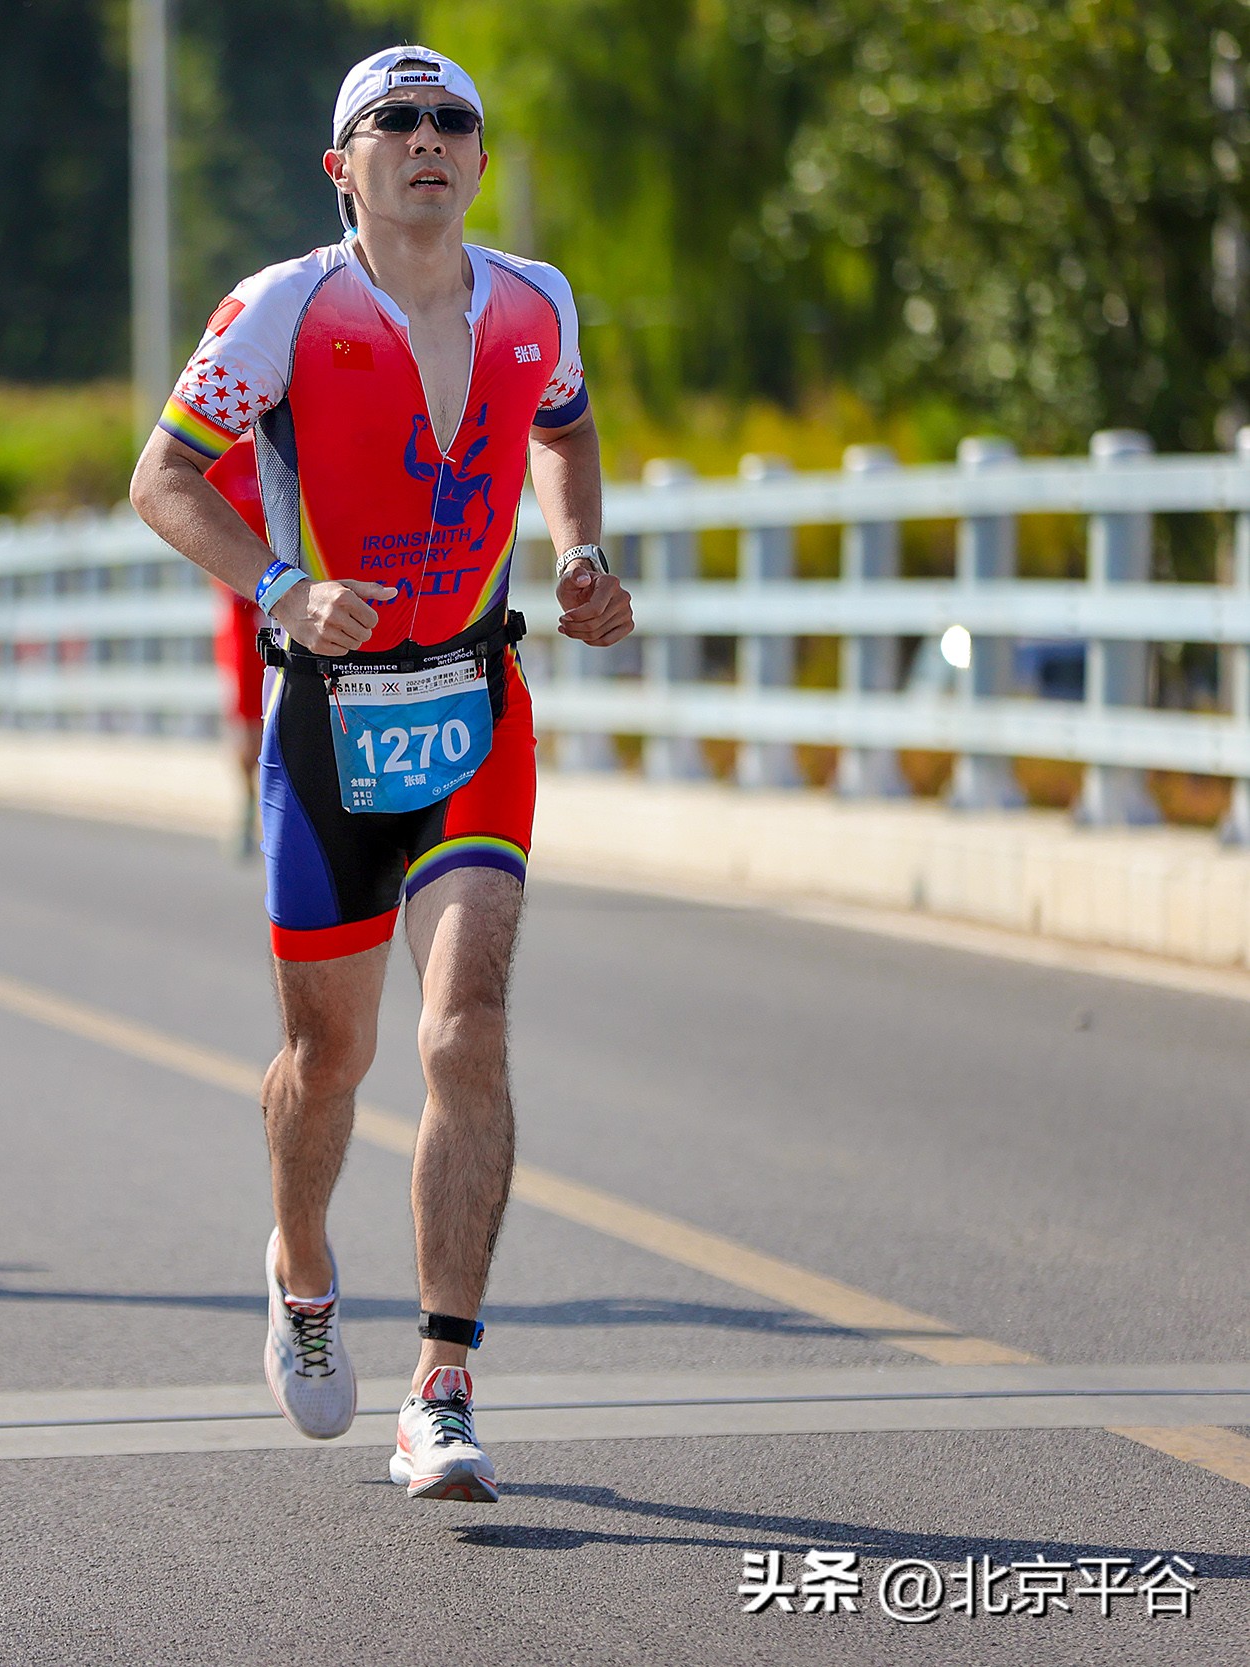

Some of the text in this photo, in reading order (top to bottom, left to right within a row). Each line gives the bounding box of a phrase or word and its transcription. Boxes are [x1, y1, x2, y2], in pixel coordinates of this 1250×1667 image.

[400, 73, 439, 83] IRONMAN
[513, 343, 542, 364] 张硕
[362, 527, 472, 551] IRONSMITH
[360, 547, 453, 570] FACTORY
[332, 662, 398, 672] performance
[437, 649, 475, 666] anti-shock
[356, 718, 471, 775] 1270
[403, 773, 427, 788] 张硕
